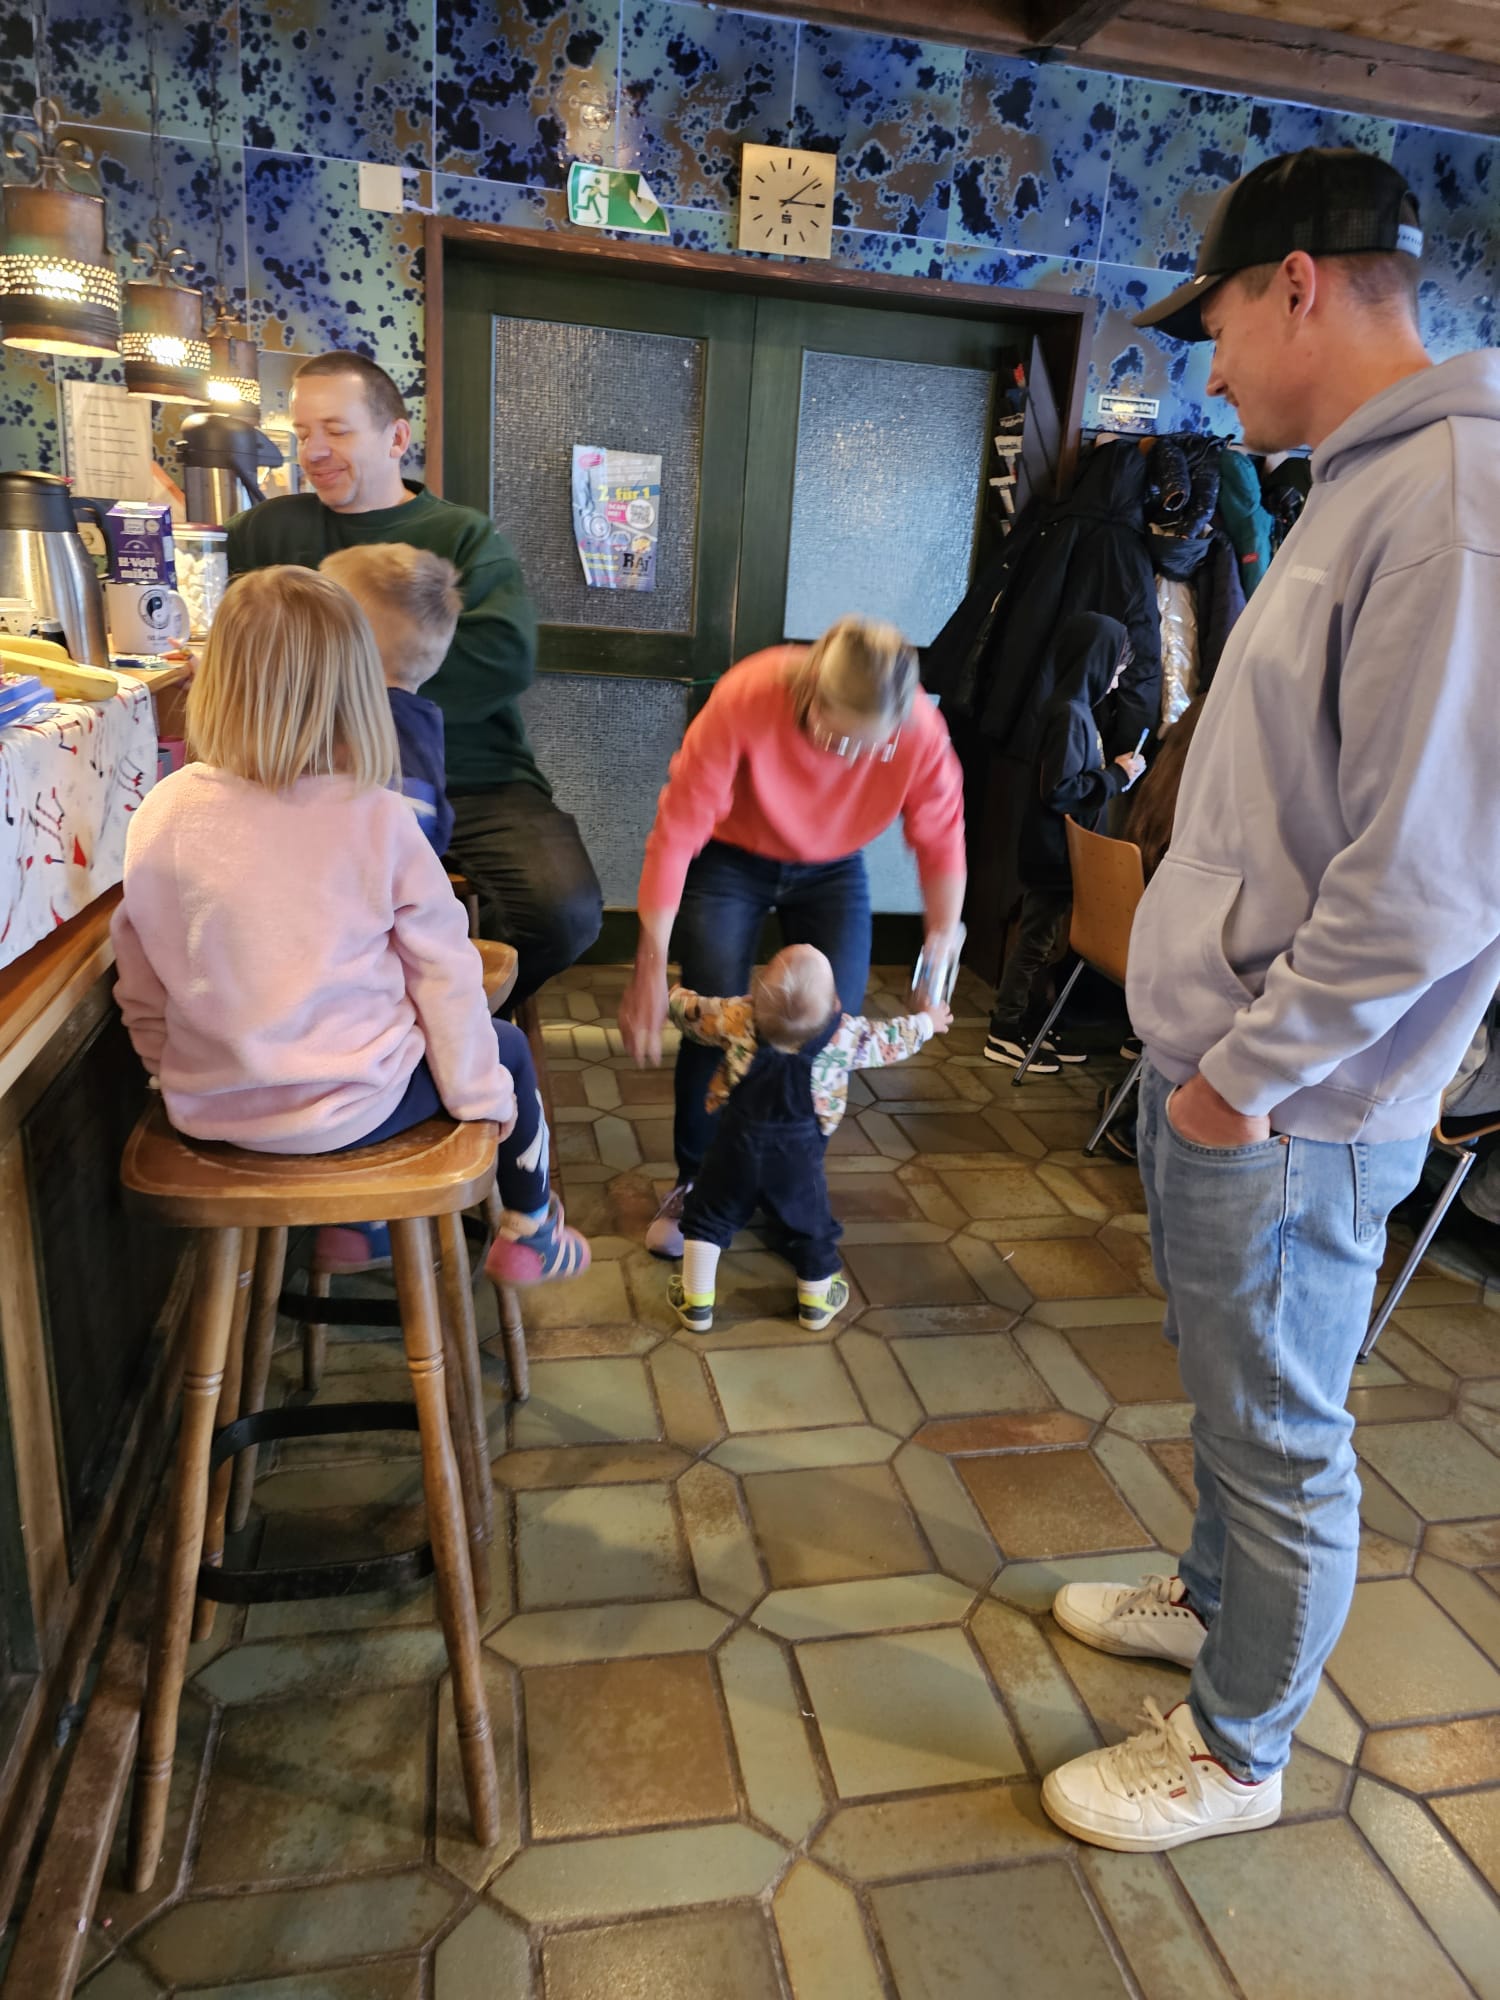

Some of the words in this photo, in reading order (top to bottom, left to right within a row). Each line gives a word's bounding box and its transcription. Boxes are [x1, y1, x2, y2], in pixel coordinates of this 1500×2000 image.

[597, 485, 609, 502] 2
[615, 486, 640, 502] für
[642, 486, 650, 500] 1
[117, 556, 160, 568] H-Voll-
[120, 568, 159, 580] milch
